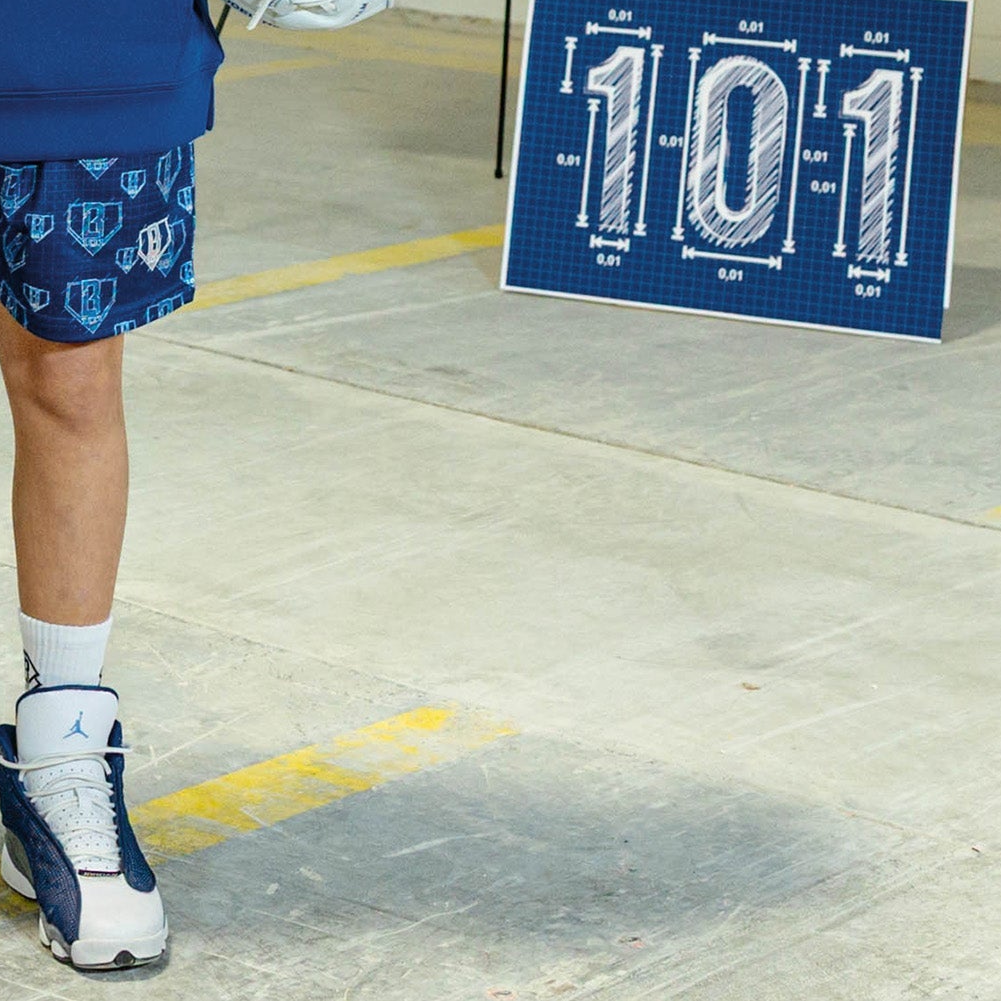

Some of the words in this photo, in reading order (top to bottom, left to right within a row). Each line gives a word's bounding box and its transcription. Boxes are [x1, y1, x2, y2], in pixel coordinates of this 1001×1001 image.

[608, 9, 633, 21] 0,01
[738, 20, 764, 33] 0,01
[864, 31, 890, 44] 0,01
[659, 135, 684, 148] 0,01
[556, 153, 581, 166] 0,01
[585, 46, 904, 267] 101
[803, 150, 828, 163] 0,01
[811, 180, 836, 194] 0,01
[596, 253, 622, 266] 0,01
[718, 268, 744, 281] 0,01
[855, 284, 881, 298] 0,01
